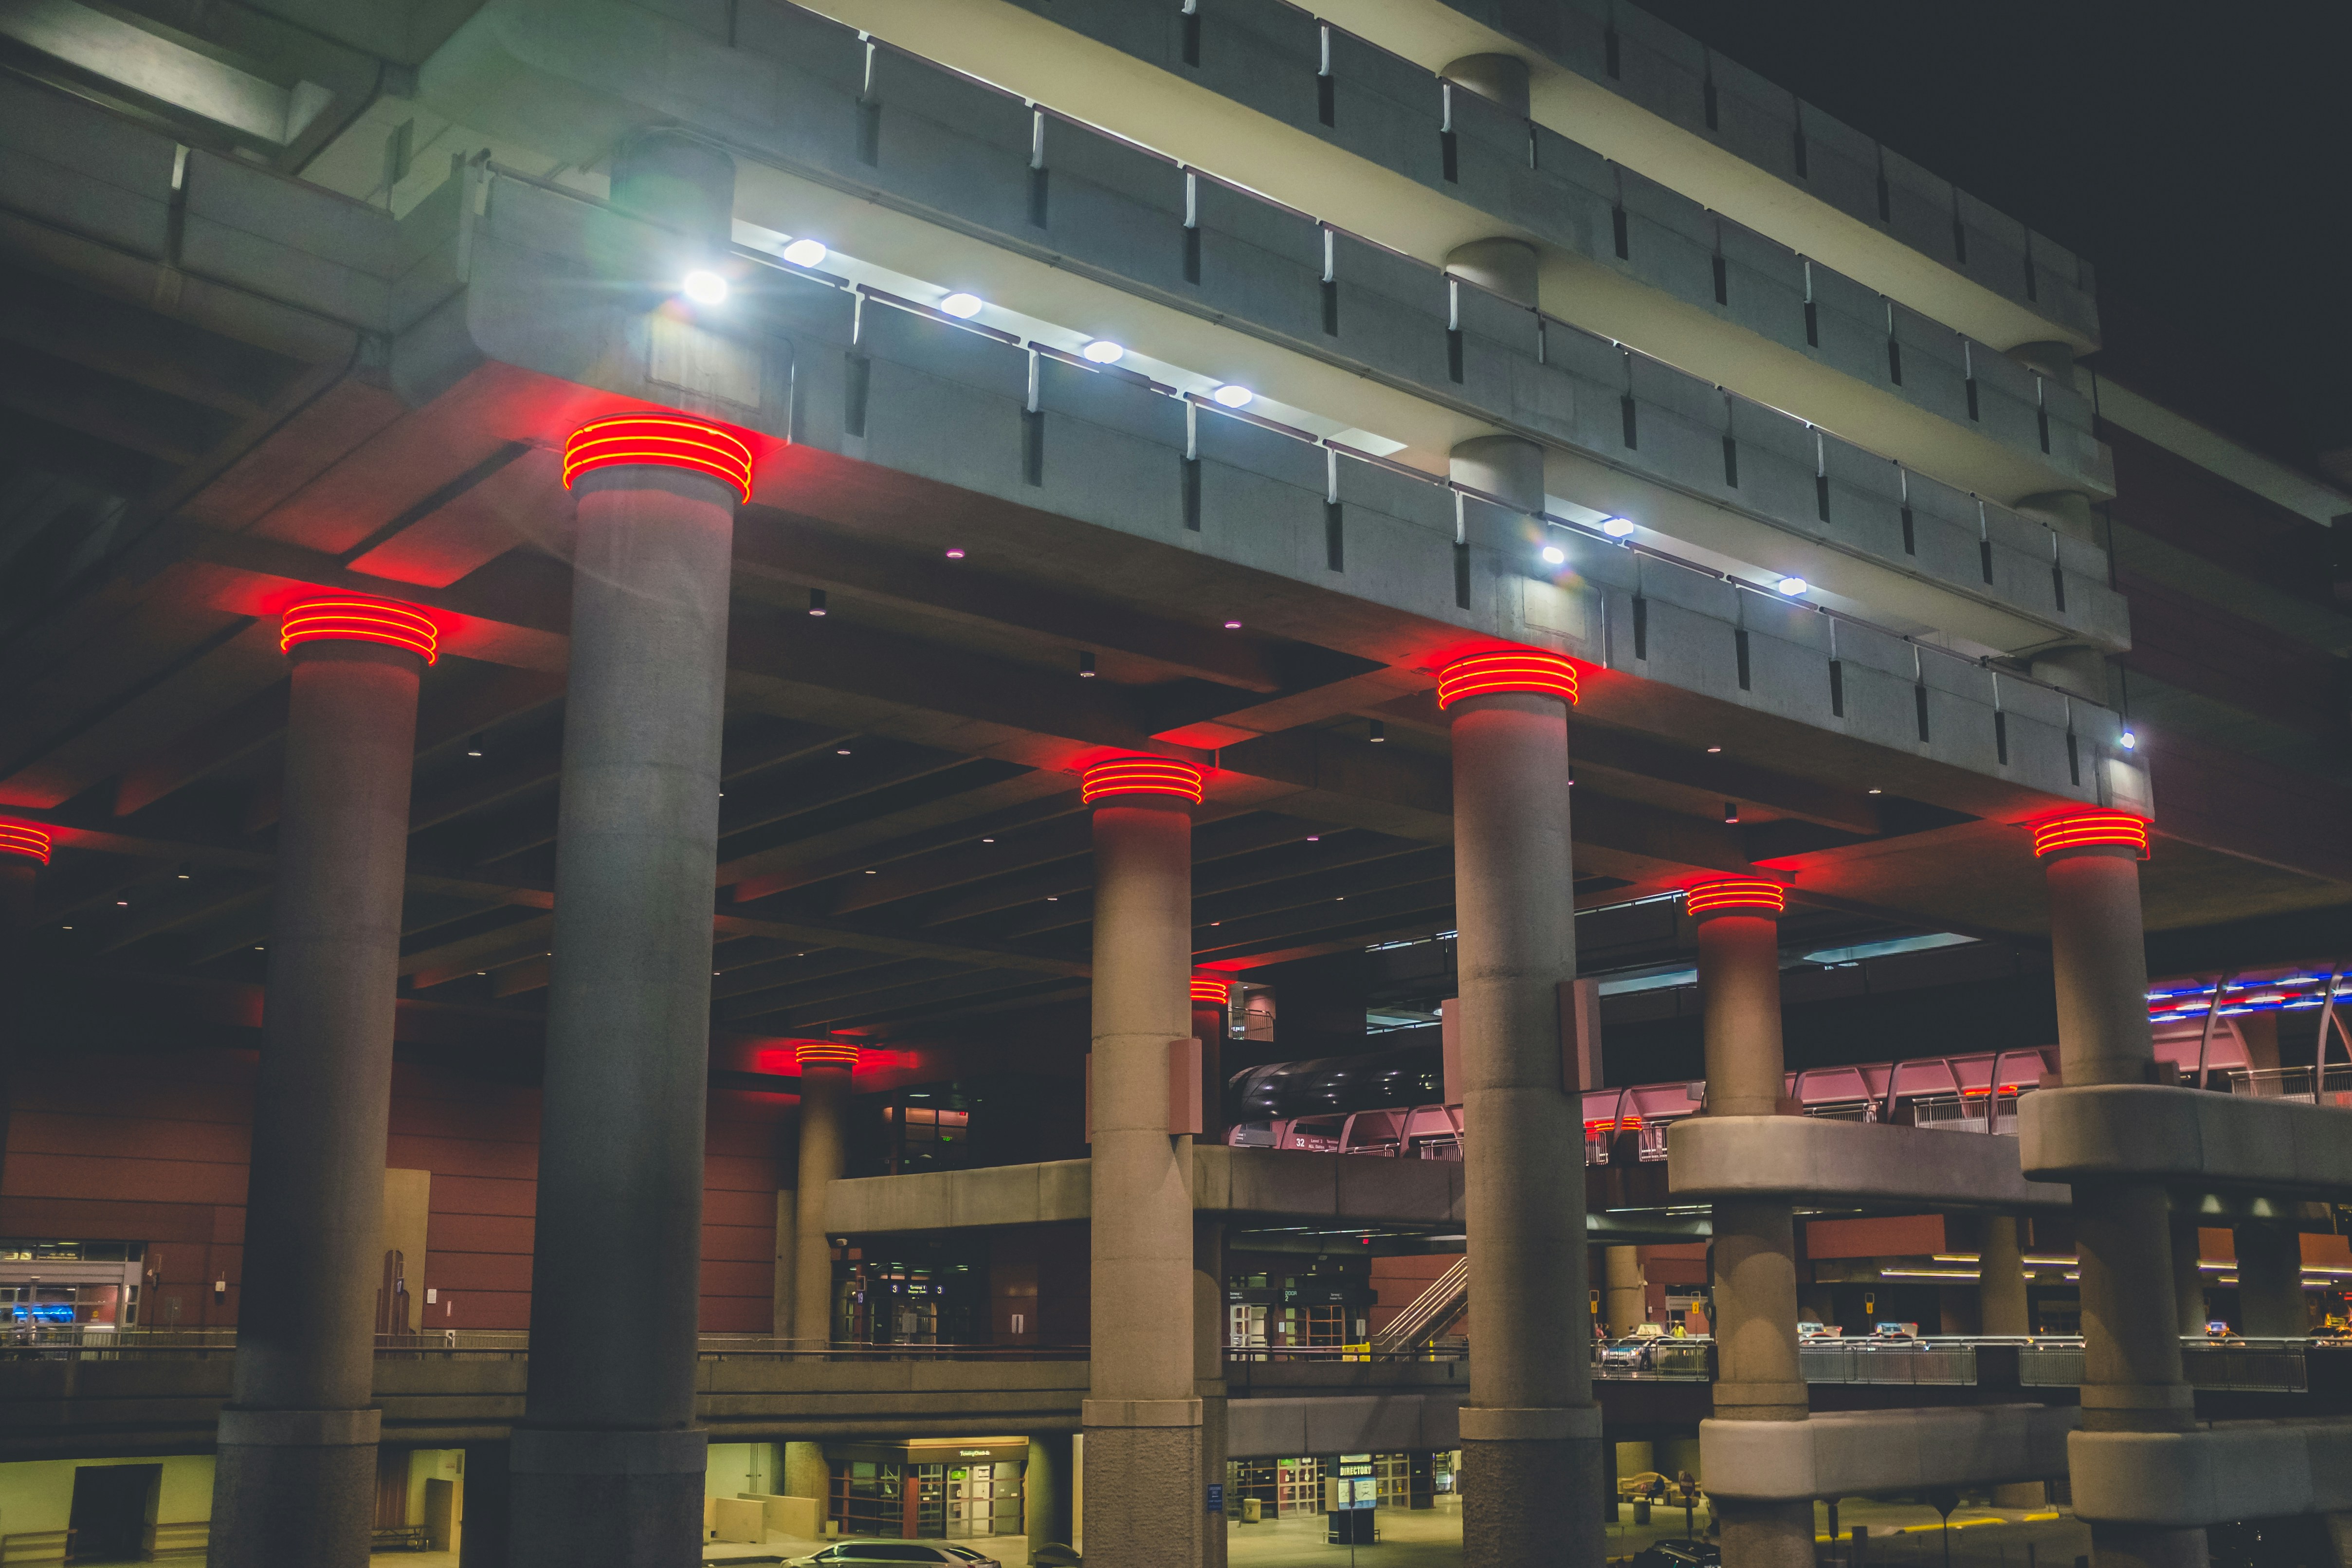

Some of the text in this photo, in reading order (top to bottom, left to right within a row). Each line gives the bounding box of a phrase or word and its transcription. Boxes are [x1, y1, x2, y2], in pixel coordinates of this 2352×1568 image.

[1296, 1138, 1305, 1147] 32
[892, 1285, 897, 1293] 3
[937, 1286, 942, 1295] 3
[857, 1293, 863, 1303] 19
[1340, 1465, 1371, 1476] DIRECTORY
